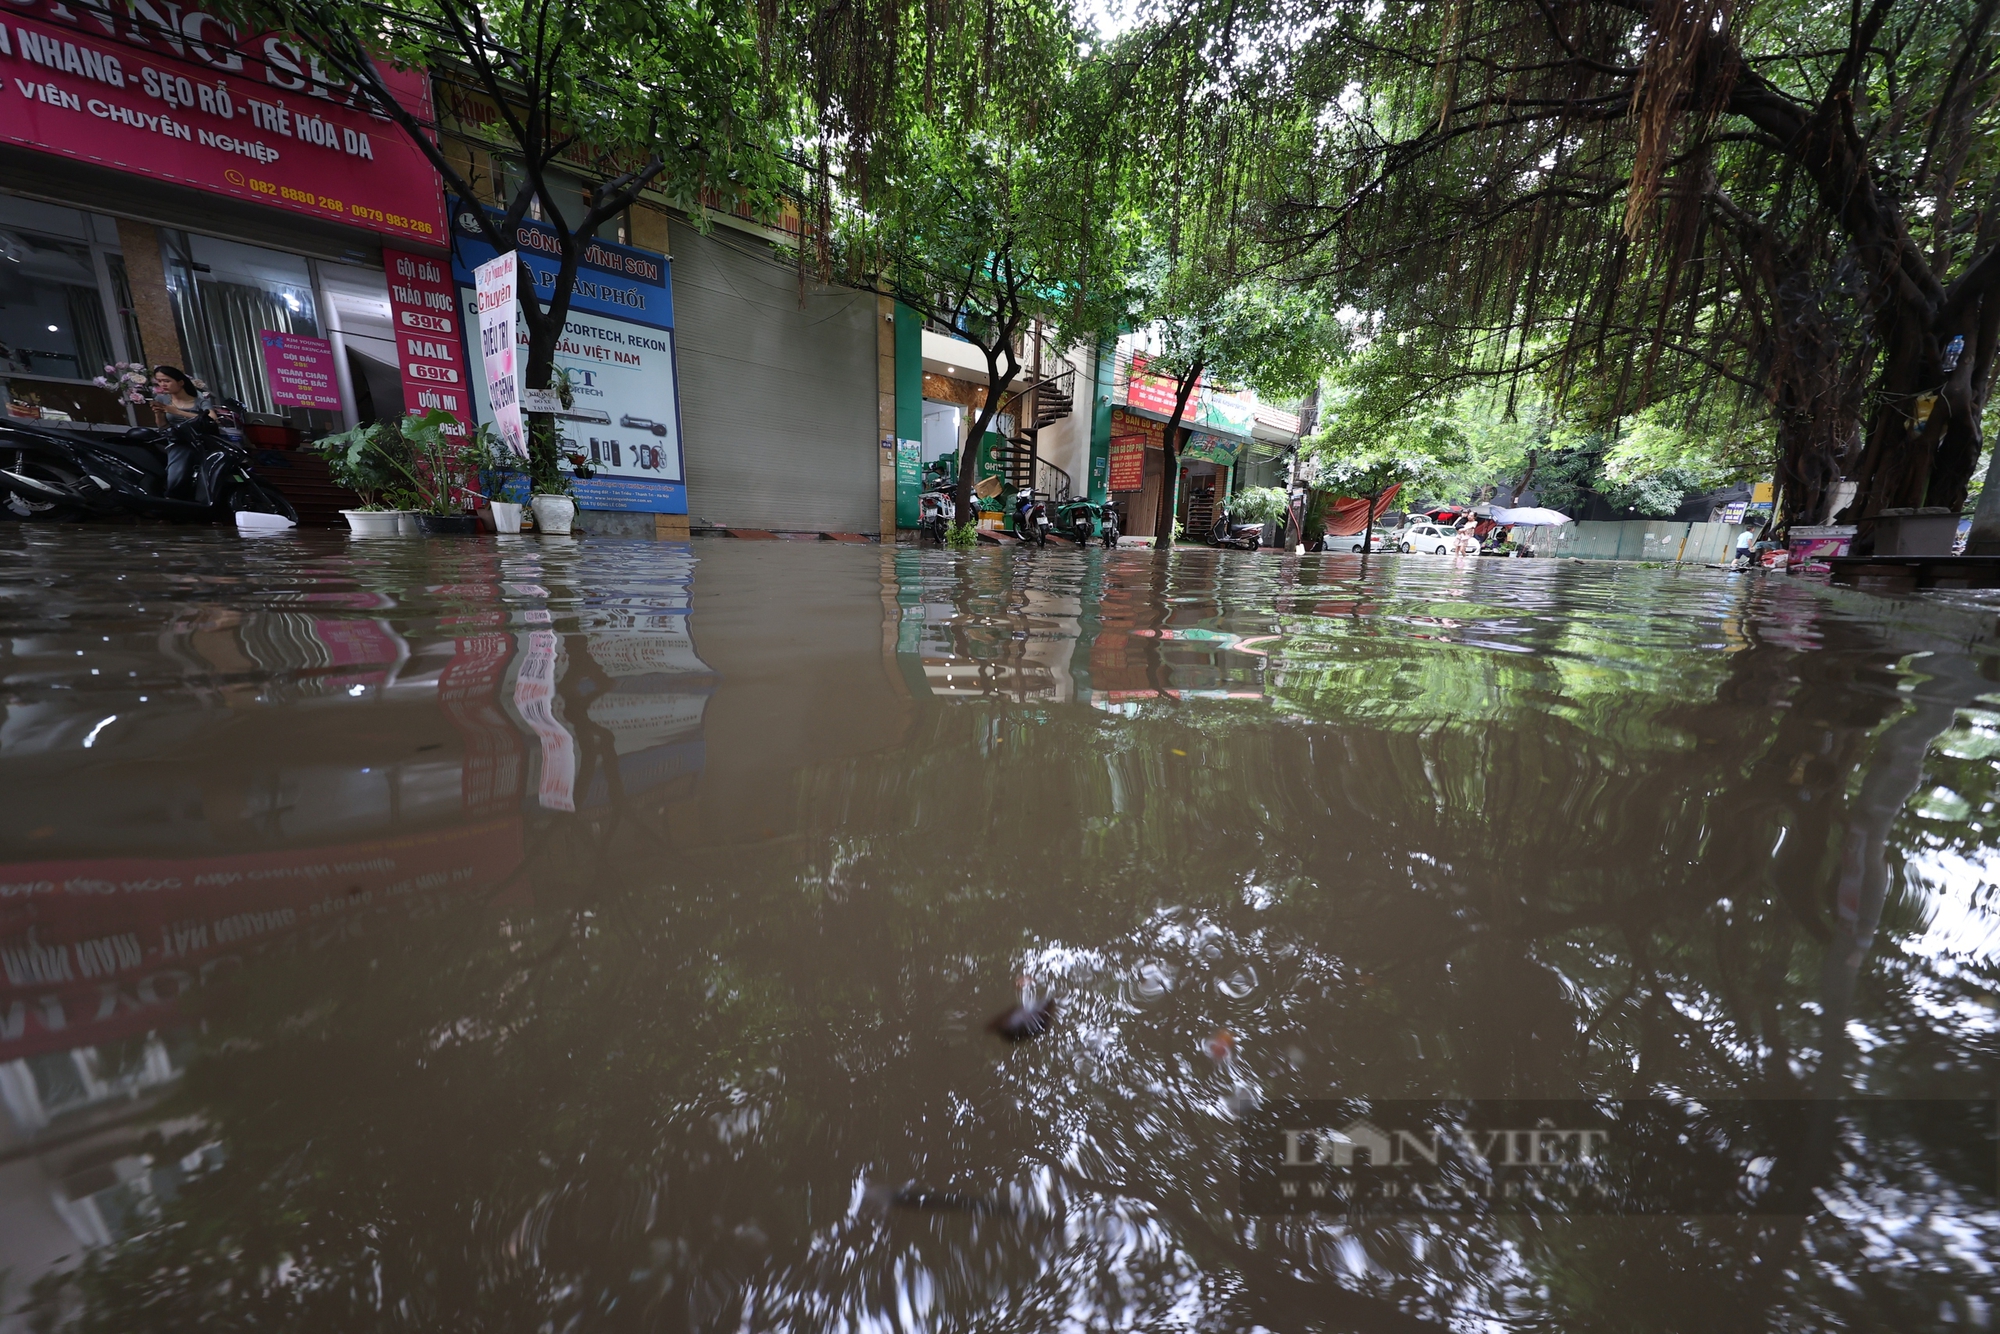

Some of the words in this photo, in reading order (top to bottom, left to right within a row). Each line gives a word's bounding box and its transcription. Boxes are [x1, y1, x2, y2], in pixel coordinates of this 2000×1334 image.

[16, 27, 126, 88] NHANG
[141, 66, 195, 110] SẸO
[197, 79, 234, 120] RỖ
[247, 99, 292, 138] TRẺ
[295, 113, 341, 151] HÓA
[343, 127, 374, 161] DA
[14, 78, 82, 112] VIÊN
[86, 98, 192, 142] CHUYÊN
[197, 128, 280, 165] NGHIỆP
[249, 178, 278, 197] 082
[280, 186, 316, 206] 8880
[318, 196, 344, 213] 268
[351, 204, 384, 222] 0979
[385, 213, 409, 229] 983
[410, 219, 433, 235] 286
[396, 257, 416, 281] GỘI
[418, 261, 441, 283] ĐẦU
[584, 244, 624, 271] VĨNH
[625, 256, 658, 281] SƠN
[392, 284, 422, 307] THẢO
[424, 291, 454, 313] DƯỢC
[601, 287, 646, 310] PHỐI
[408, 313, 445, 331] 39K
[407, 339, 454, 361] NAIL
[565, 321, 626, 345] CORTECH,
[628, 336, 667, 353] REKON
[582, 344, 612, 361] VIỆT
[614, 352, 641, 366] NAM
[416, 365, 453, 382] 69K
[418, 389, 441, 409] UỐN
[443, 395, 458, 411] MI
